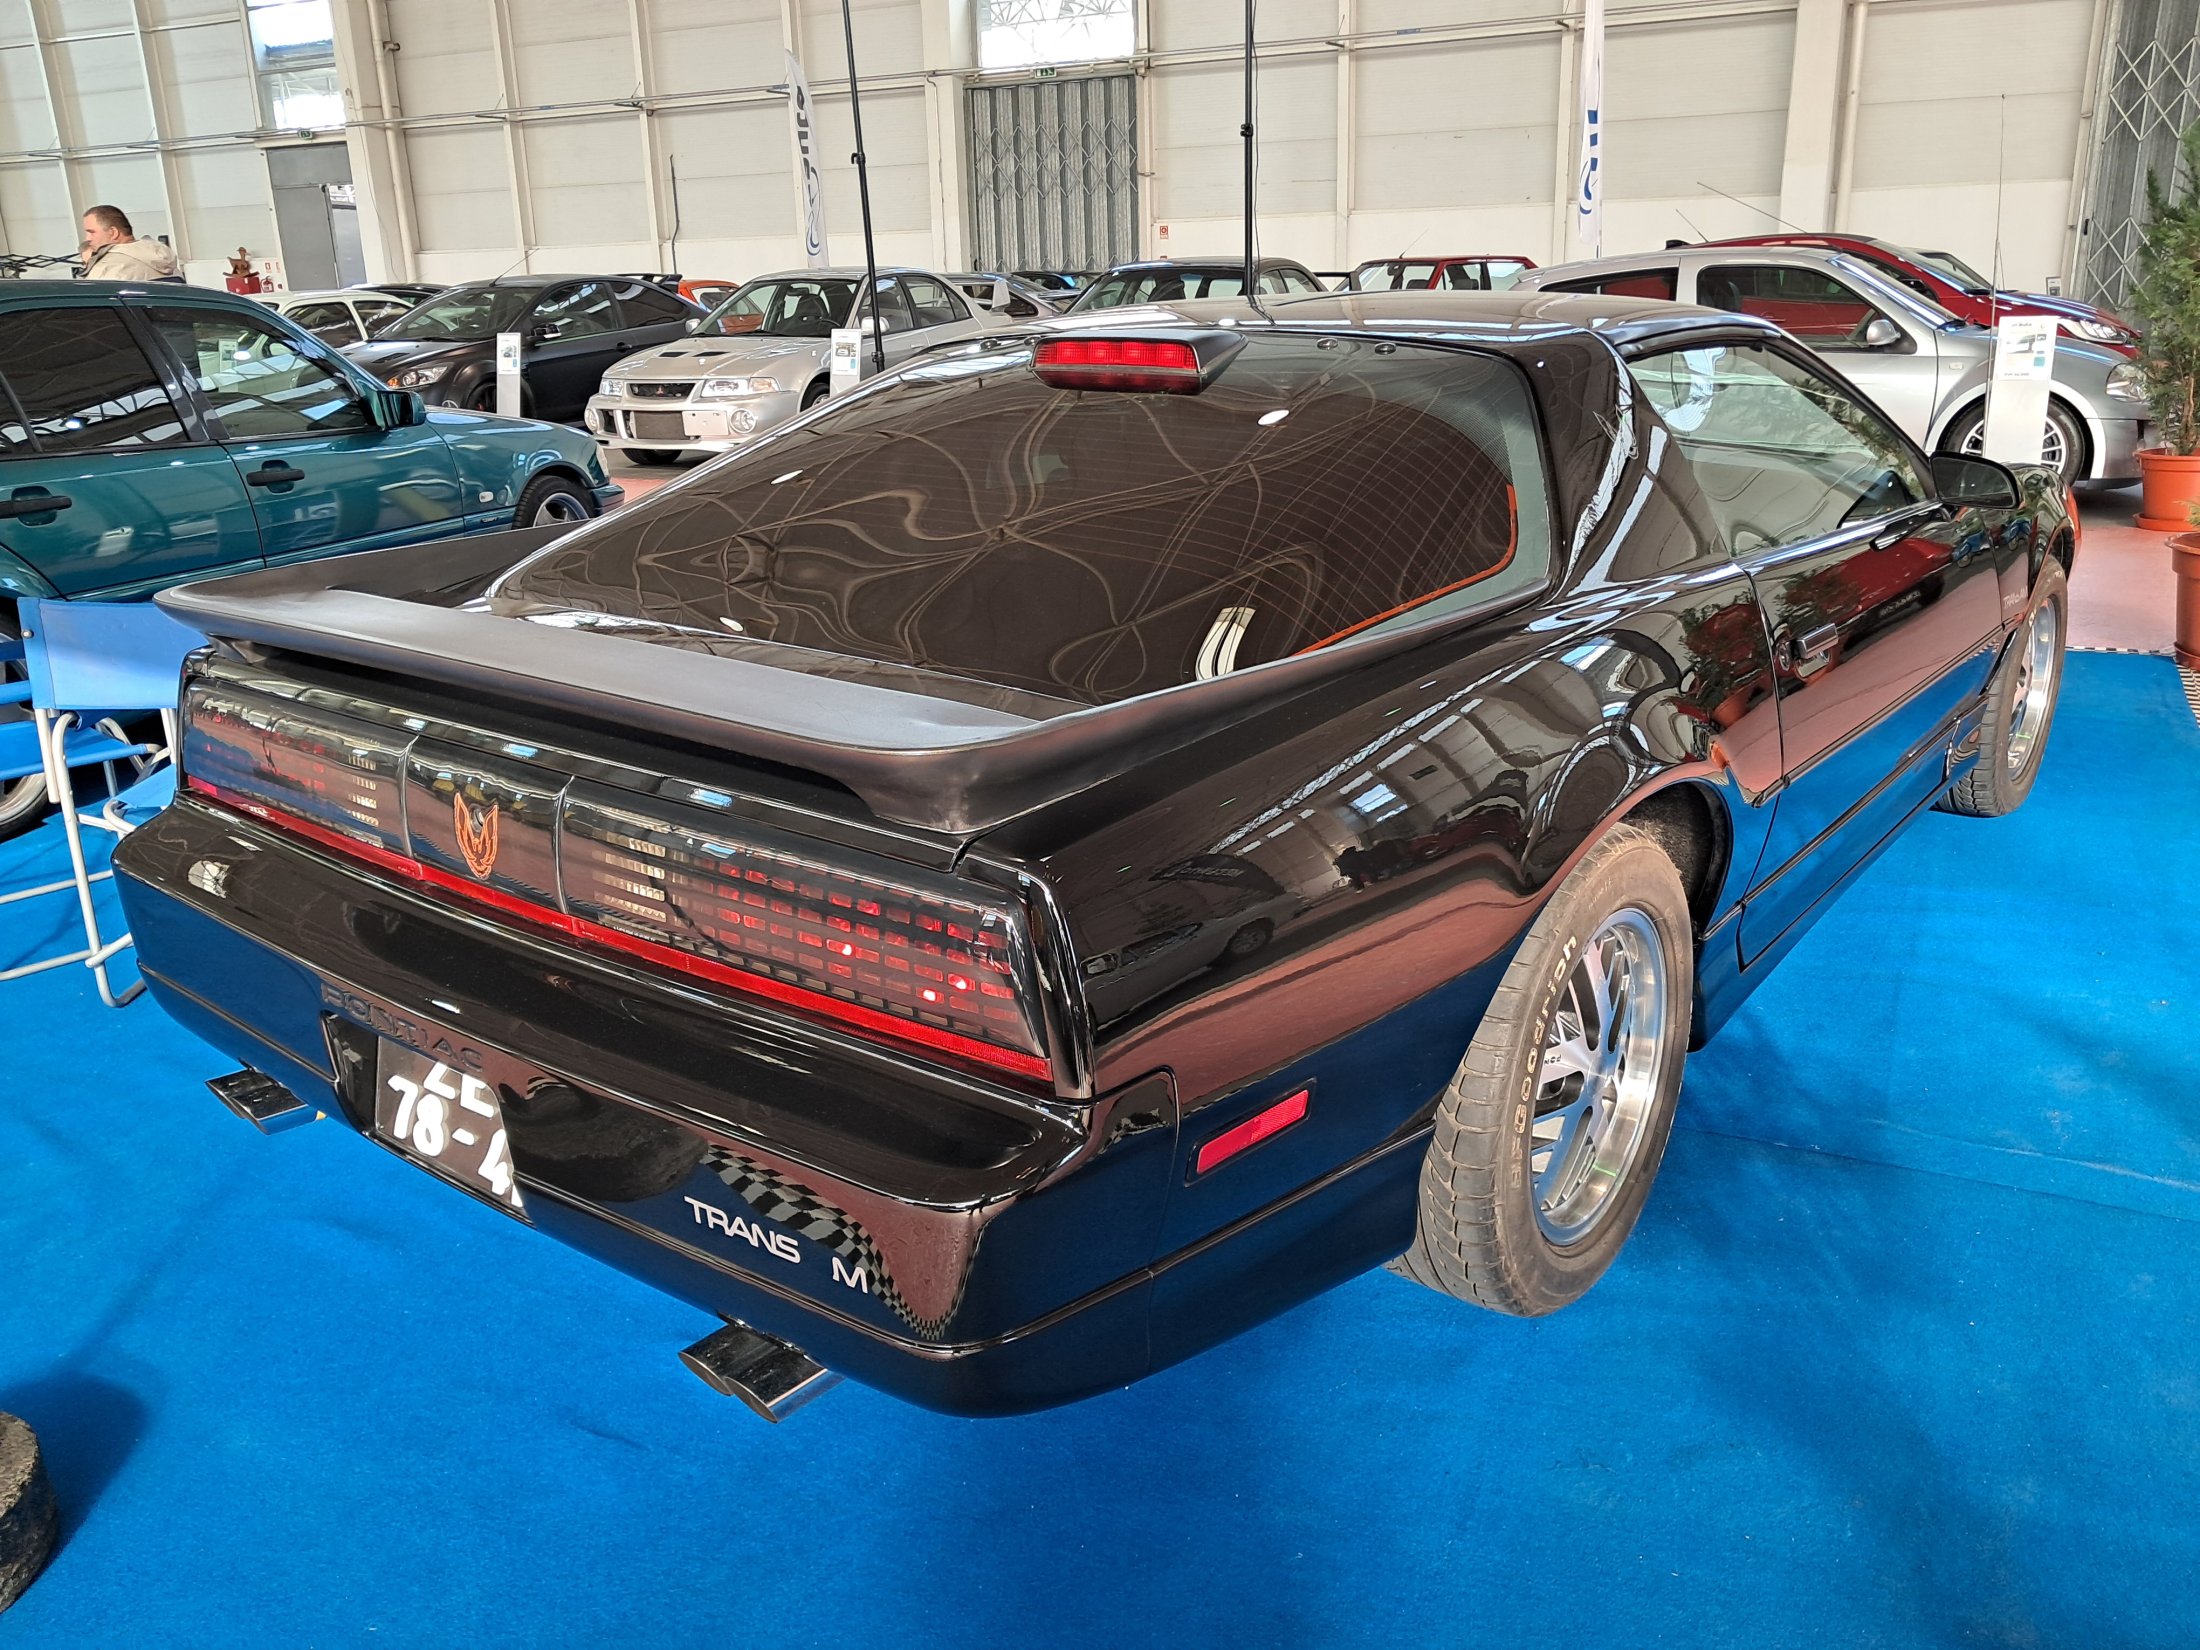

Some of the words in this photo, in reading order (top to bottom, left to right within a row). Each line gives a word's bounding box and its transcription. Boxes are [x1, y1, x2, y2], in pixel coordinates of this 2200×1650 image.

[319, 983, 483, 1073] PONTIAC
[387, 1075, 523, 1208] 78-4
[684, 1195, 800, 1264] TRANS
